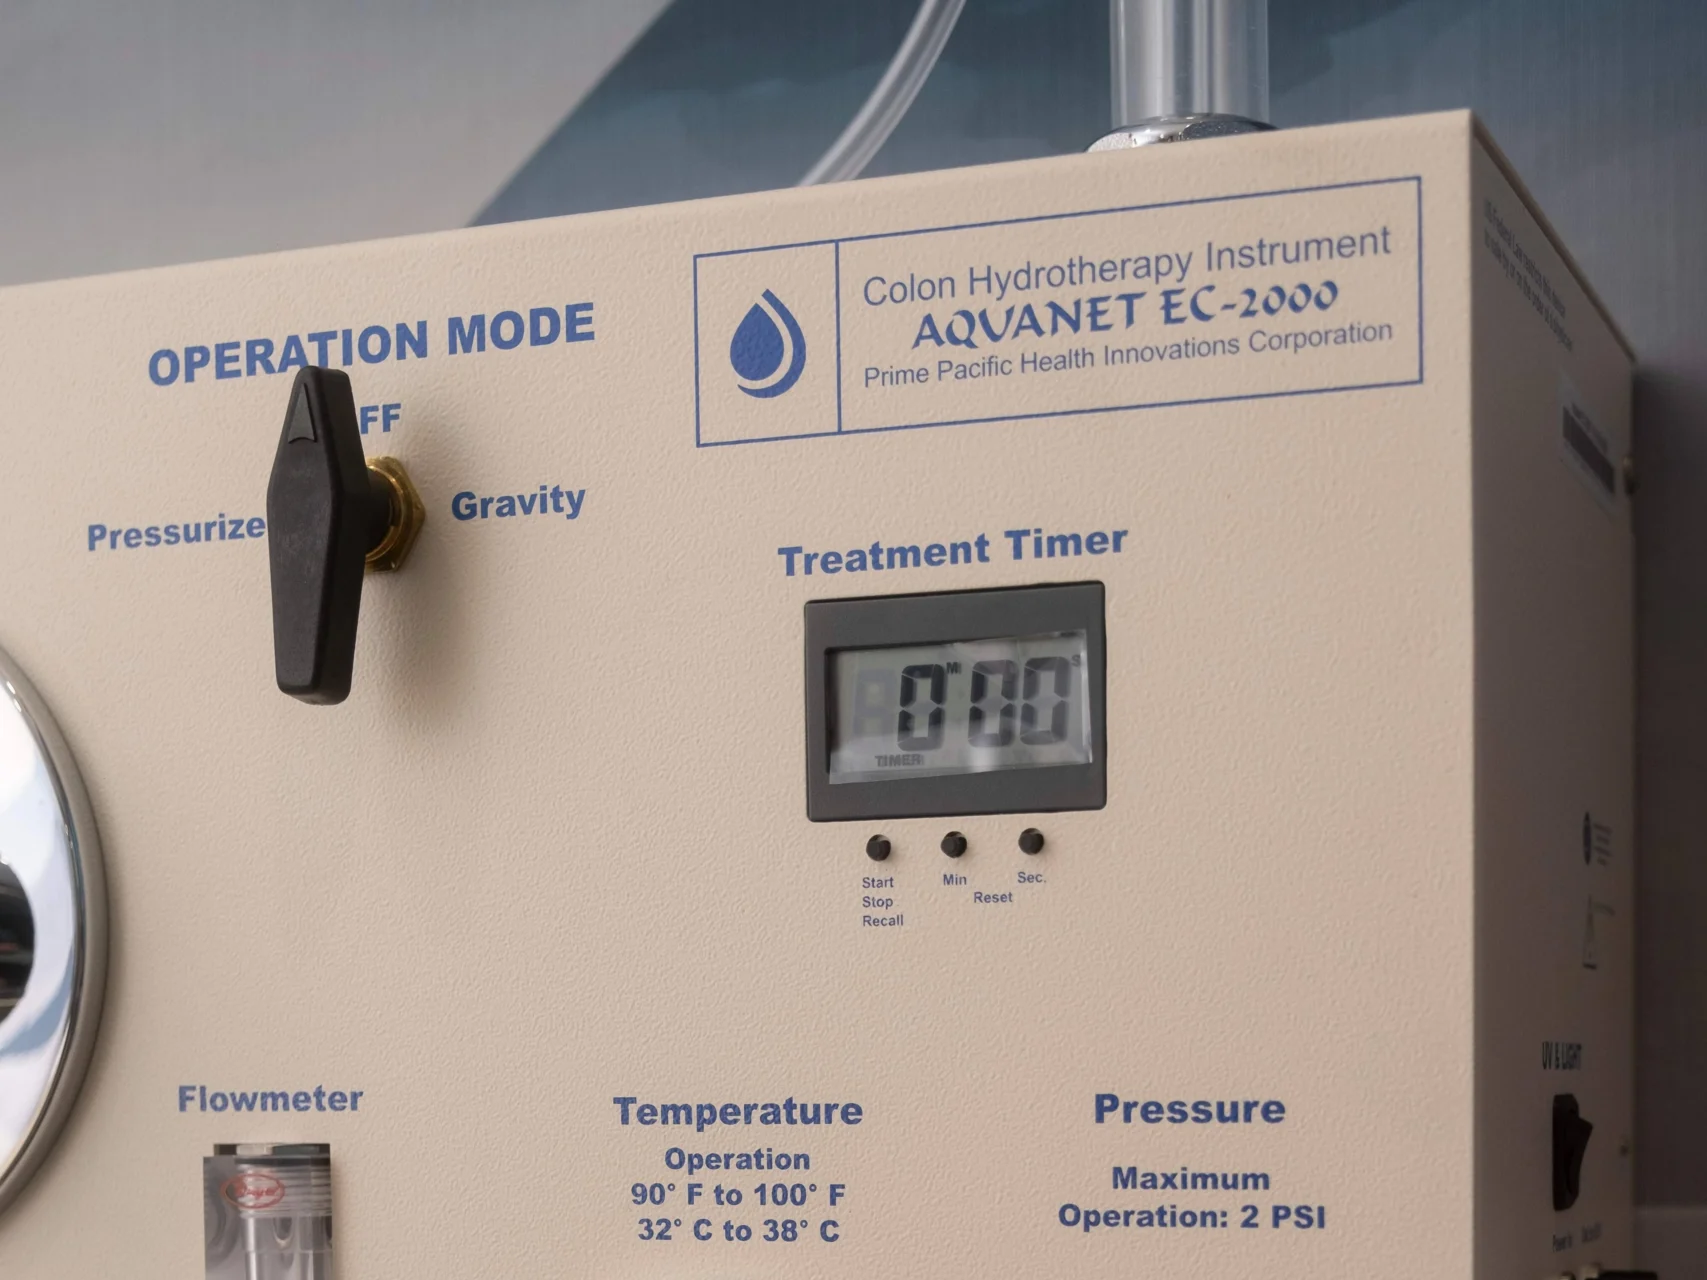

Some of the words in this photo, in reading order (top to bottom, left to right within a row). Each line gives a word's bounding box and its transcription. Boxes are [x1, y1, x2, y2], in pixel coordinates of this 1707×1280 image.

[863, 272, 956, 307] Colon
[968, 247, 1193, 300] Hydrotherapy
[1206, 226, 1391, 271] Instrument
[1159, 279, 1340, 327] EC-2000
[148, 319, 429, 387] OPERATION
[447, 302, 596, 355] MODE
[865, 364, 930, 388] Prime
[937, 355, 1012, 382] Pacific
[1020, 347, 1095, 372] Health
[1104, 336, 1240, 367] Innovations
[1249, 322, 1393, 355] Corporation
[359, 403, 401, 435] FF
[451, 483, 586, 521] Gravity
[777, 532, 991, 577] Treatment
[1004, 528, 1129, 562] Timer
[875, 753, 923, 767] TIMER
[862, 876, 894, 889] Start
[943, 873, 967, 886] Min
[1017, 871, 1047, 884] Sec.
[862, 895, 893, 910] Stop
[973, 891, 1013, 904] Reset
[862, 914, 904, 927] Recall
[177, 1084, 364, 1113] Flowmeter
[1094, 1092, 1286, 1125] Pressure
[612, 1096, 864, 1131] Temperature
[664, 1147, 811, 1176] Operation
[1112, 1166, 1271, 1191] Maximum
[631, 1183, 675, 1206] 90°
[687, 1183, 704, 1206] F
[714, 1184, 743, 1206] to
[754, 1183, 816, 1206] 100°
[828, 1183, 846, 1206] F
[637, 1217, 683, 1241] 32°
[693, 1218, 713, 1241] C
[723, 1219, 753, 1242] to
[763, 1218, 809, 1242] 38°
[819, 1219, 840, 1243] C
[1058, 1203, 1229, 1233] Operation:
[1240, 1204, 1259, 1230] 2
[1272, 1204, 1326, 1230] PSI
